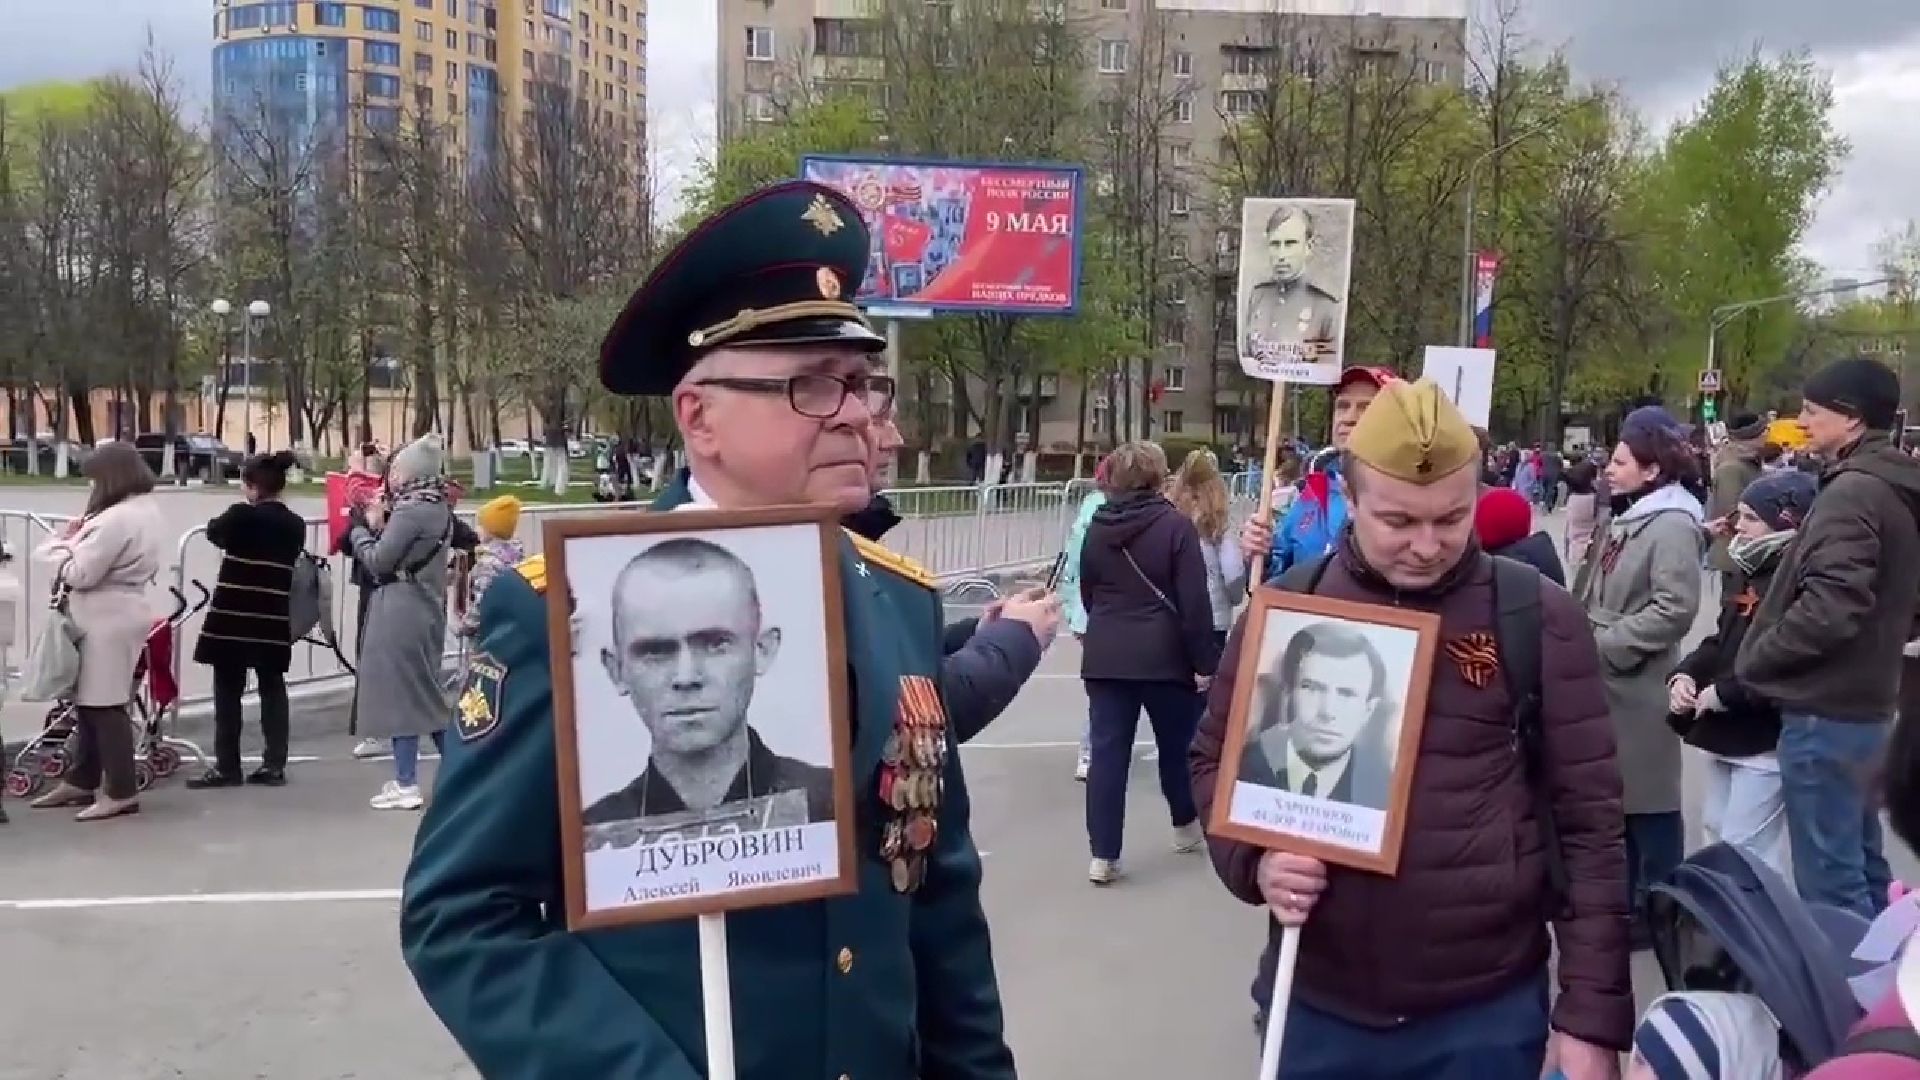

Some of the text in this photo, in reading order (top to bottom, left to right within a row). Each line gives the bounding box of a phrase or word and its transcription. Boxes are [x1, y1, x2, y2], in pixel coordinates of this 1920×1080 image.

[986, 211, 1068, 235] 9 МАЯ
[635, 828, 804, 877] ДУБРОВИН
[623, 862, 822, 903] Алексей Яковлевич
